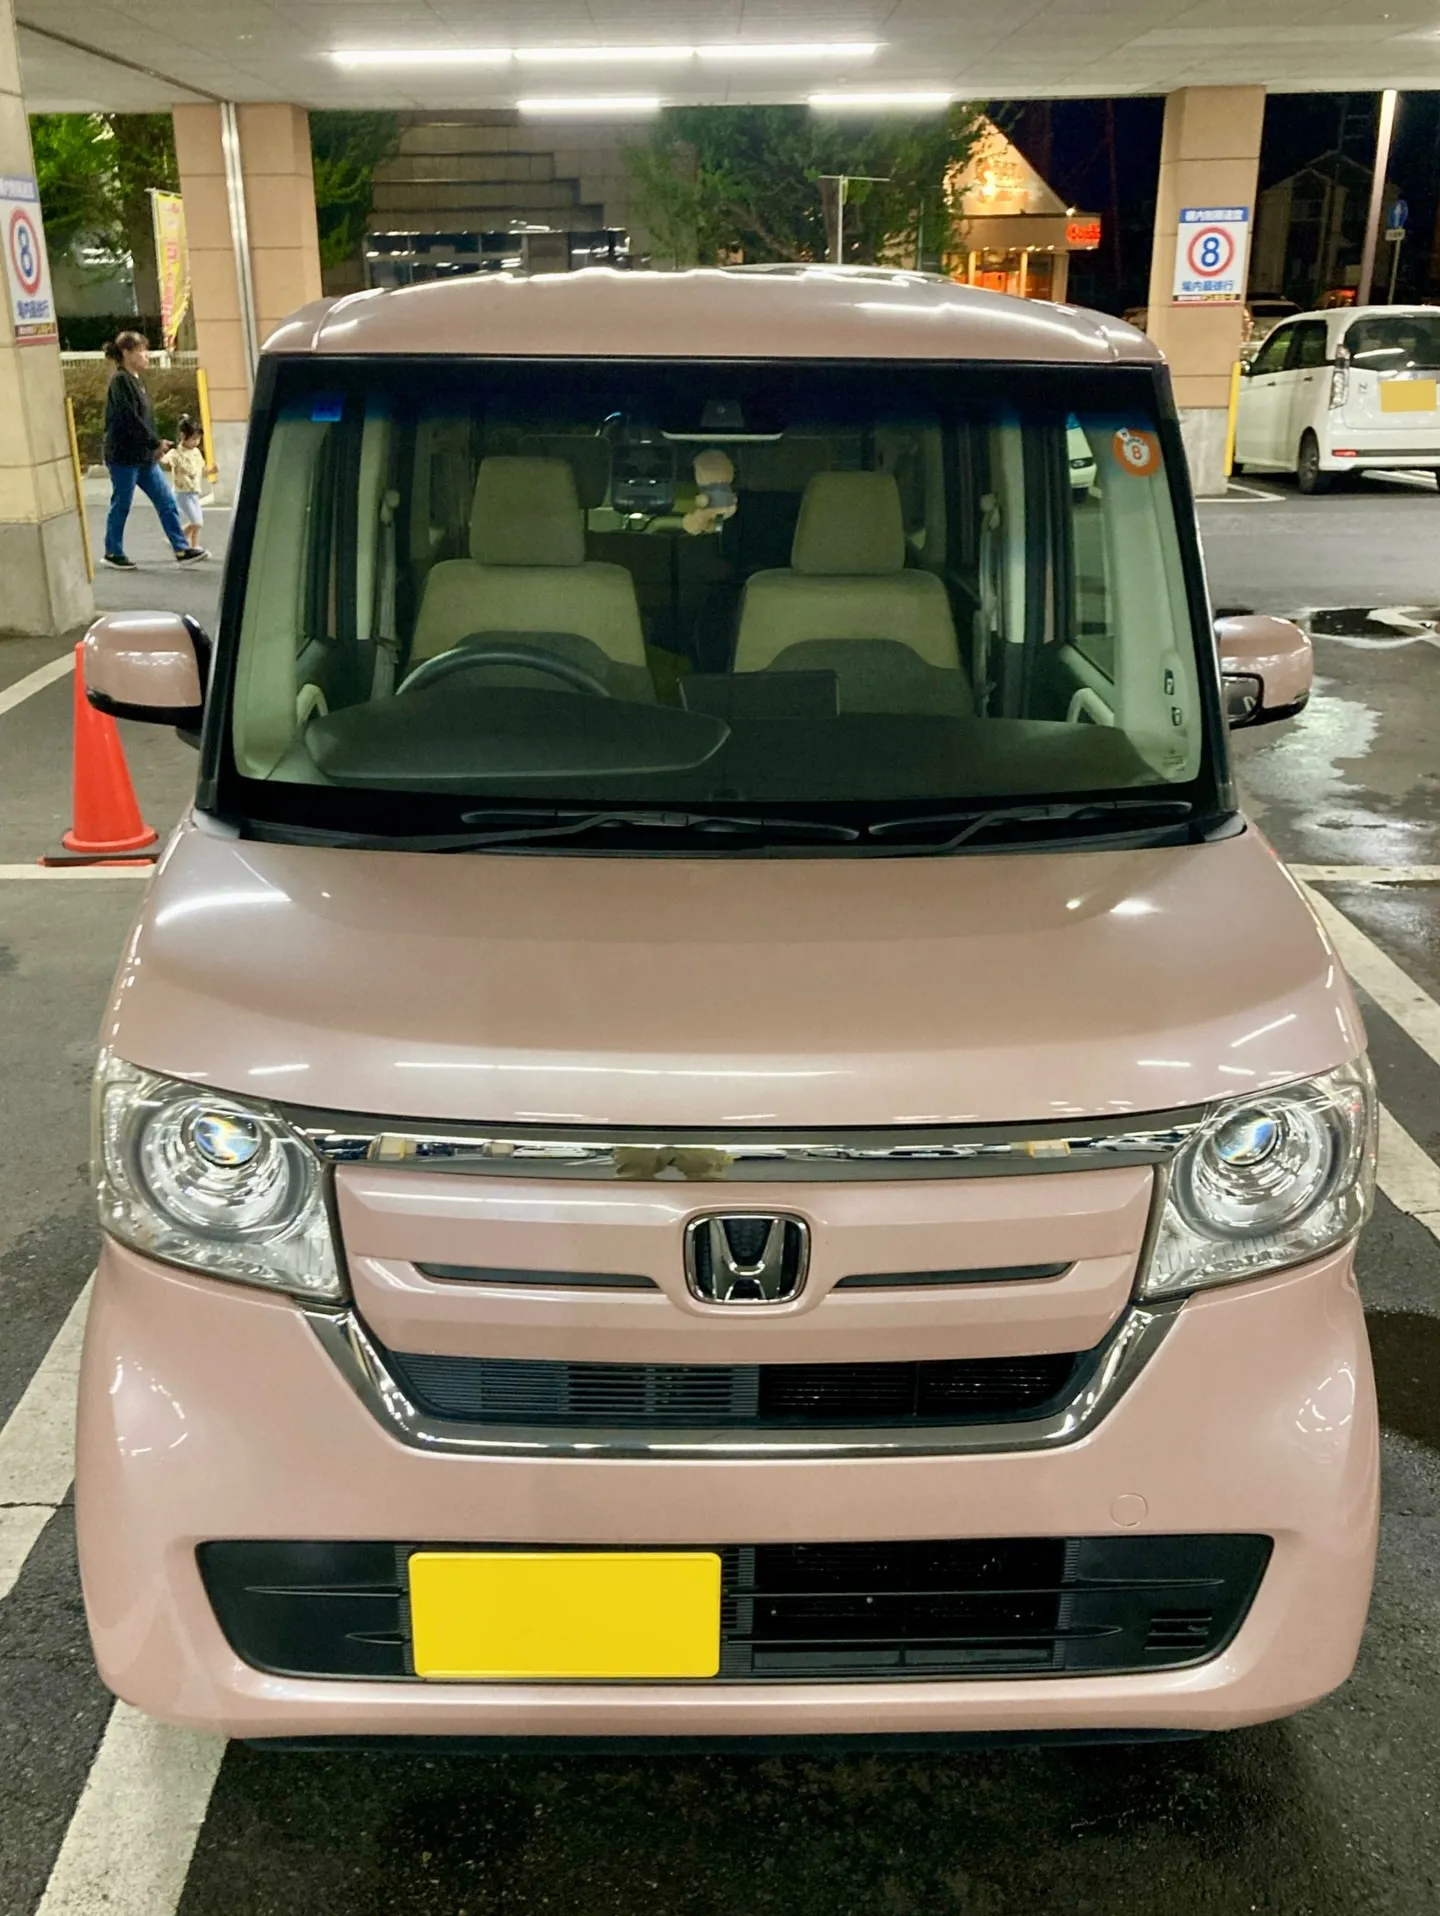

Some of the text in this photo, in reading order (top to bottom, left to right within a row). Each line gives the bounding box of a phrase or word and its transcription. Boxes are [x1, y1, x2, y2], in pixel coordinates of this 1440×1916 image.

[18, 226, 33, 278] 8
[1201, 237, 1220, 267] 8
[1131, 444, 1143, 460] 8
